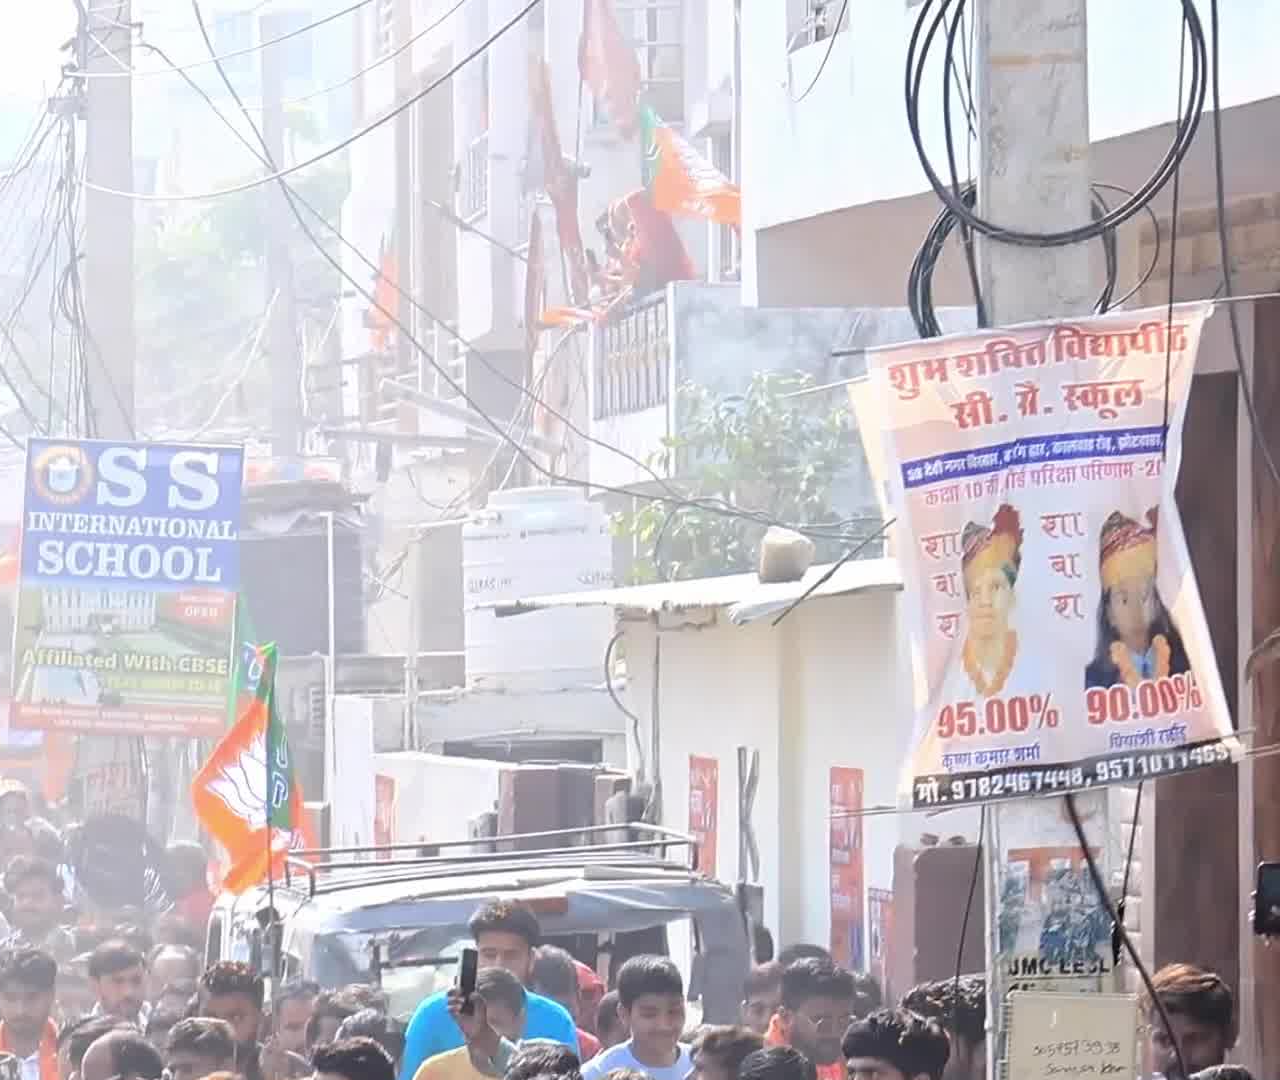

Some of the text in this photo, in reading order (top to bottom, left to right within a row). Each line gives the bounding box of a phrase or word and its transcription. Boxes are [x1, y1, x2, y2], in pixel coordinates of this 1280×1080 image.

[1061, 378, 1144, 420] स्कूल
[95, 447, 219, 511] S S
[26, 511, 239, 541] INTERNATIONAL
[37, 539, 222, 583] SCHOOL
[21, 648, 118, 672] Affiliated
[123, 653, 172, 672] With
[937, 690, 1060, 740] 95.00%
[1086, 672, 1203, 726] 90.00%
